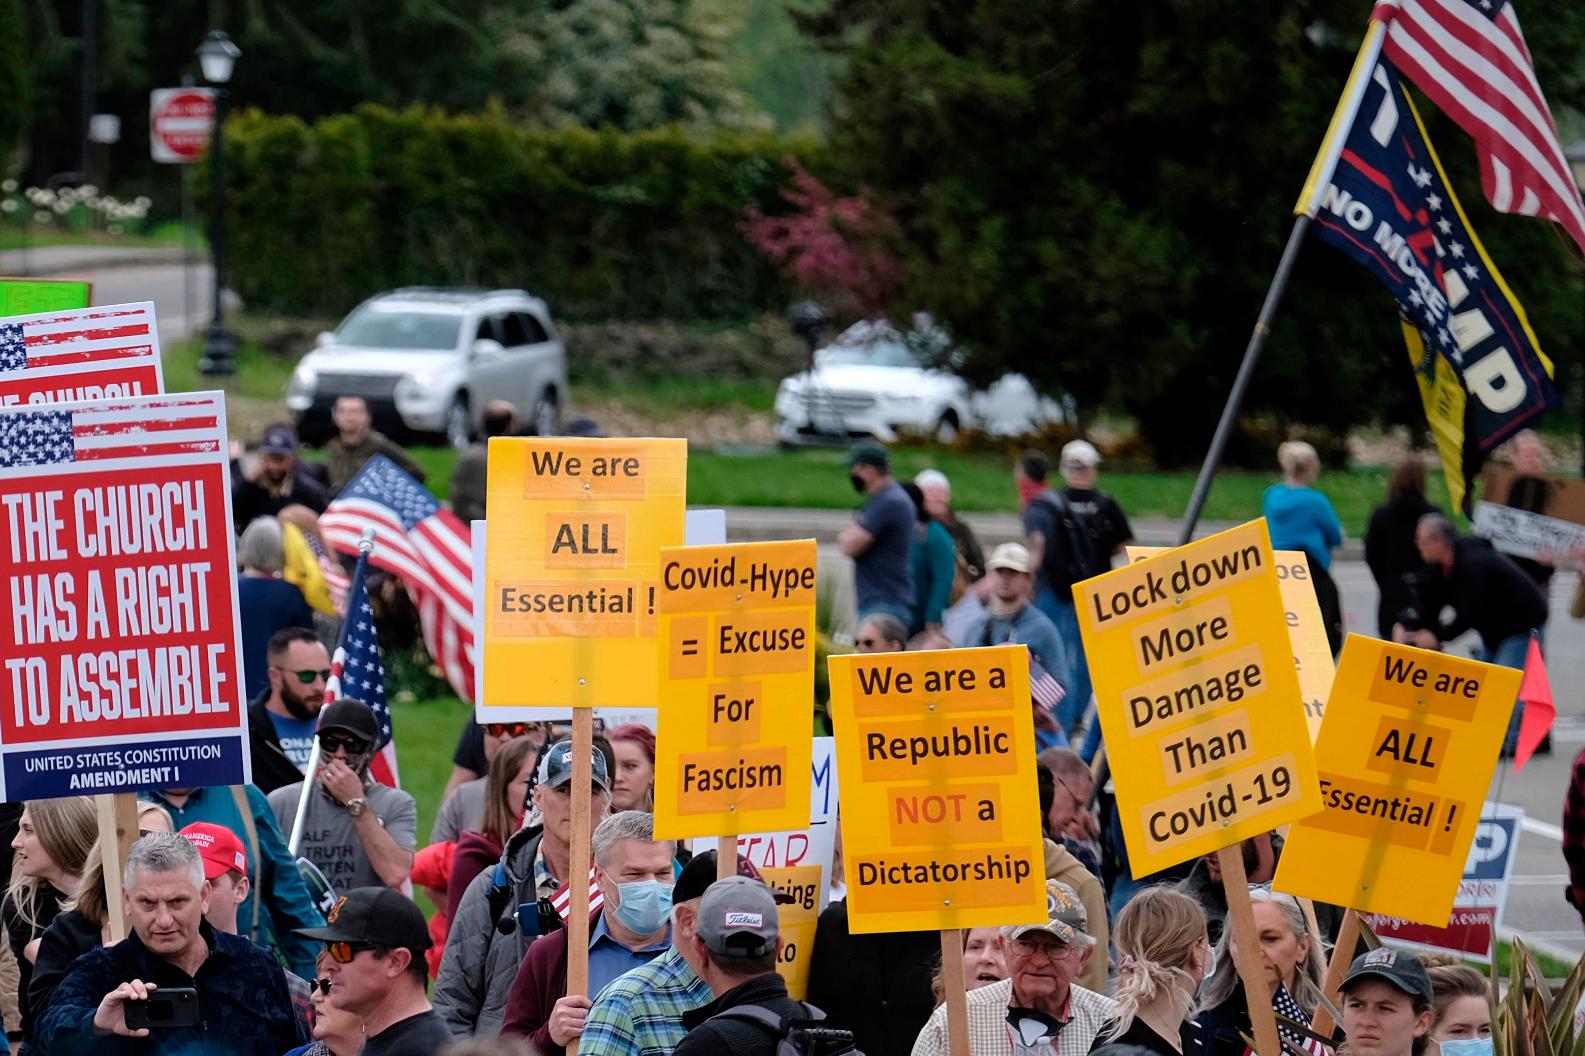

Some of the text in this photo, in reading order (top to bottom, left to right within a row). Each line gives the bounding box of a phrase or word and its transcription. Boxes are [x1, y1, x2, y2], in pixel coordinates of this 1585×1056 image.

[1320, 183, 1373, 232] NO
[1373, 219, 1447, 321] MORE
[531, 451, 639, 477] We are
[1, 480, 208, 564] THE CHURCH
[551, 523, 618, 554] ALL
[10, 562, 211, 645] HAS A RIGHT
[501, 587, 633, 614] Essential
[719, 625, 805, 654] Excuse
[1140, 615, 1228, 665] More
[5, 643, 229, 727] TO ASSEMBLE
[857, 667, 1006, 695] We are a
[1384, 656, 1479, 698] We are
[713, 694, 755, 723] For
[1130, 662, 1262, 728] Damage
[25, 744, 221, 773] UNITED STATES CONSTITUTION
[867, 725, 1009, 765] Republic
[1165, 728, 1248, 774] Than
[1376, 729, 1435, 767] ALL
[69, 766, 179, 789] AMENDMENT I
[683, 759, 782, 792] Fascism
[895, 794, 995, 825] NOT a
[302, 830, 330, 841] ALF
[305, 845, 353, 858] TRUTH
[319, 861, 354, 874] FTEN
[858, 854, 1030, 886] Dictatorship
